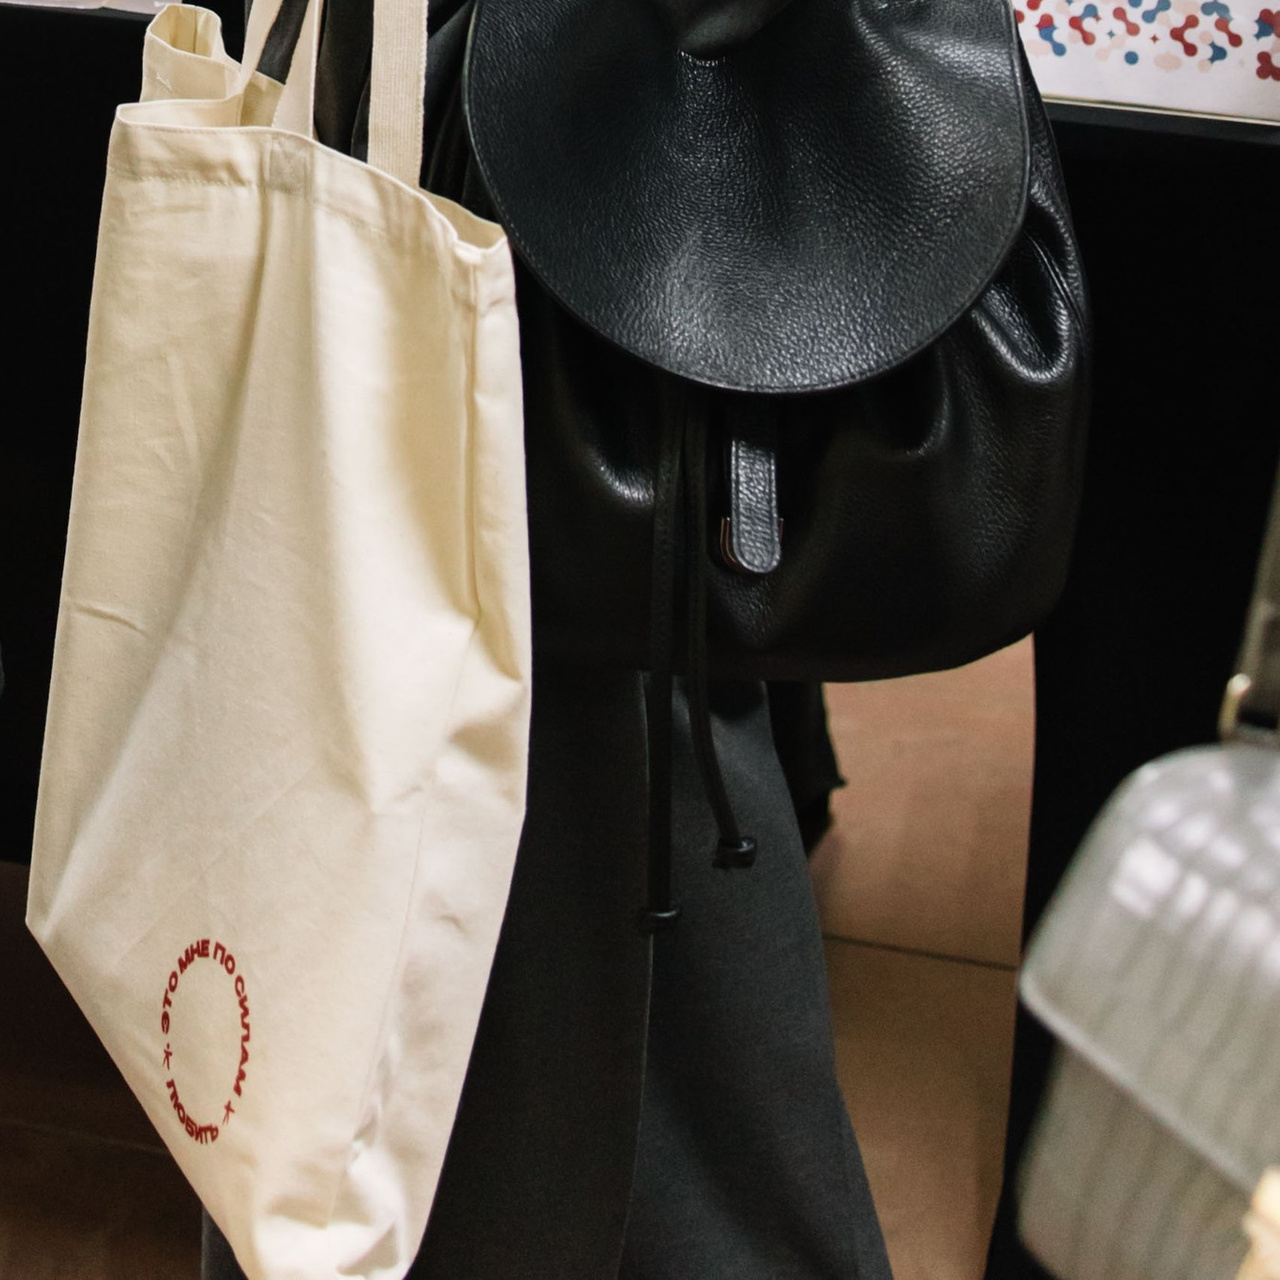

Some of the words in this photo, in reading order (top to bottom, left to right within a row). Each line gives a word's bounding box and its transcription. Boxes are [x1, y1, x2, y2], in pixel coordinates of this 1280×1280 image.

[161, 970, 178, 1035] ЭТО
[178, 939, 210, 975] МНЕ
[213, 941, 236, 975] ПО
[234, 975, 250, 1097] СИЛАМ
